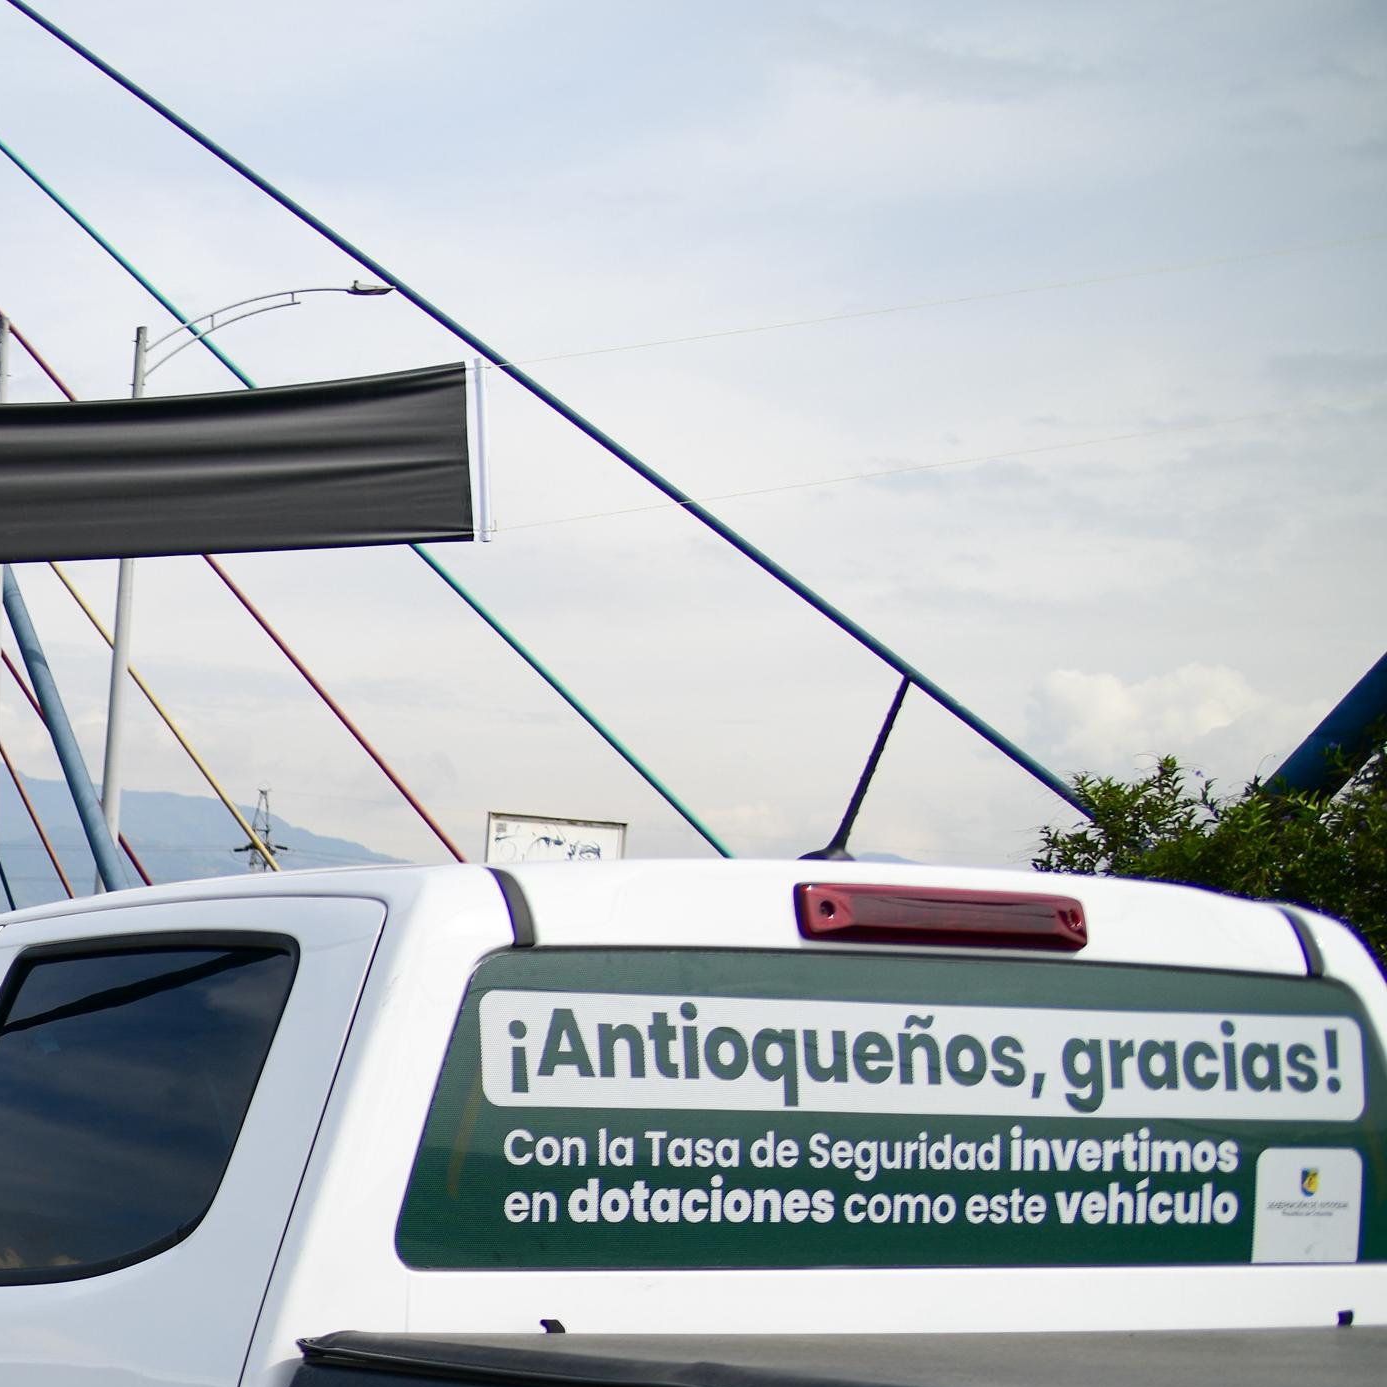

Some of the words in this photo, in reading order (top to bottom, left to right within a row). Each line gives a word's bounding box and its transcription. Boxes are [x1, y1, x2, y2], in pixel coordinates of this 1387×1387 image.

[508, 1001, 1046, 1110] ¡Antioqueños,
[1061, 1020, 1342, 1114] gracias!
[503, 1129, 587, 1167] Con
[598, 1127, 634, 1167] la
[644, 1130, 740, 1168] Tasa
[749, 1130, 800, 1168] de
[808, 1131, 1001, 1181] Seguridad
[1010, 1125, 1238, 1173] invertimos
[503, 1191, 557, 1223] en
[567, 1174, 835, 1224] dotaciones
[843, 1193, 957, 1224] como
[965, 1188, 1047, 1224] este
[1054, 1177, 1239, 1224] vehículo
